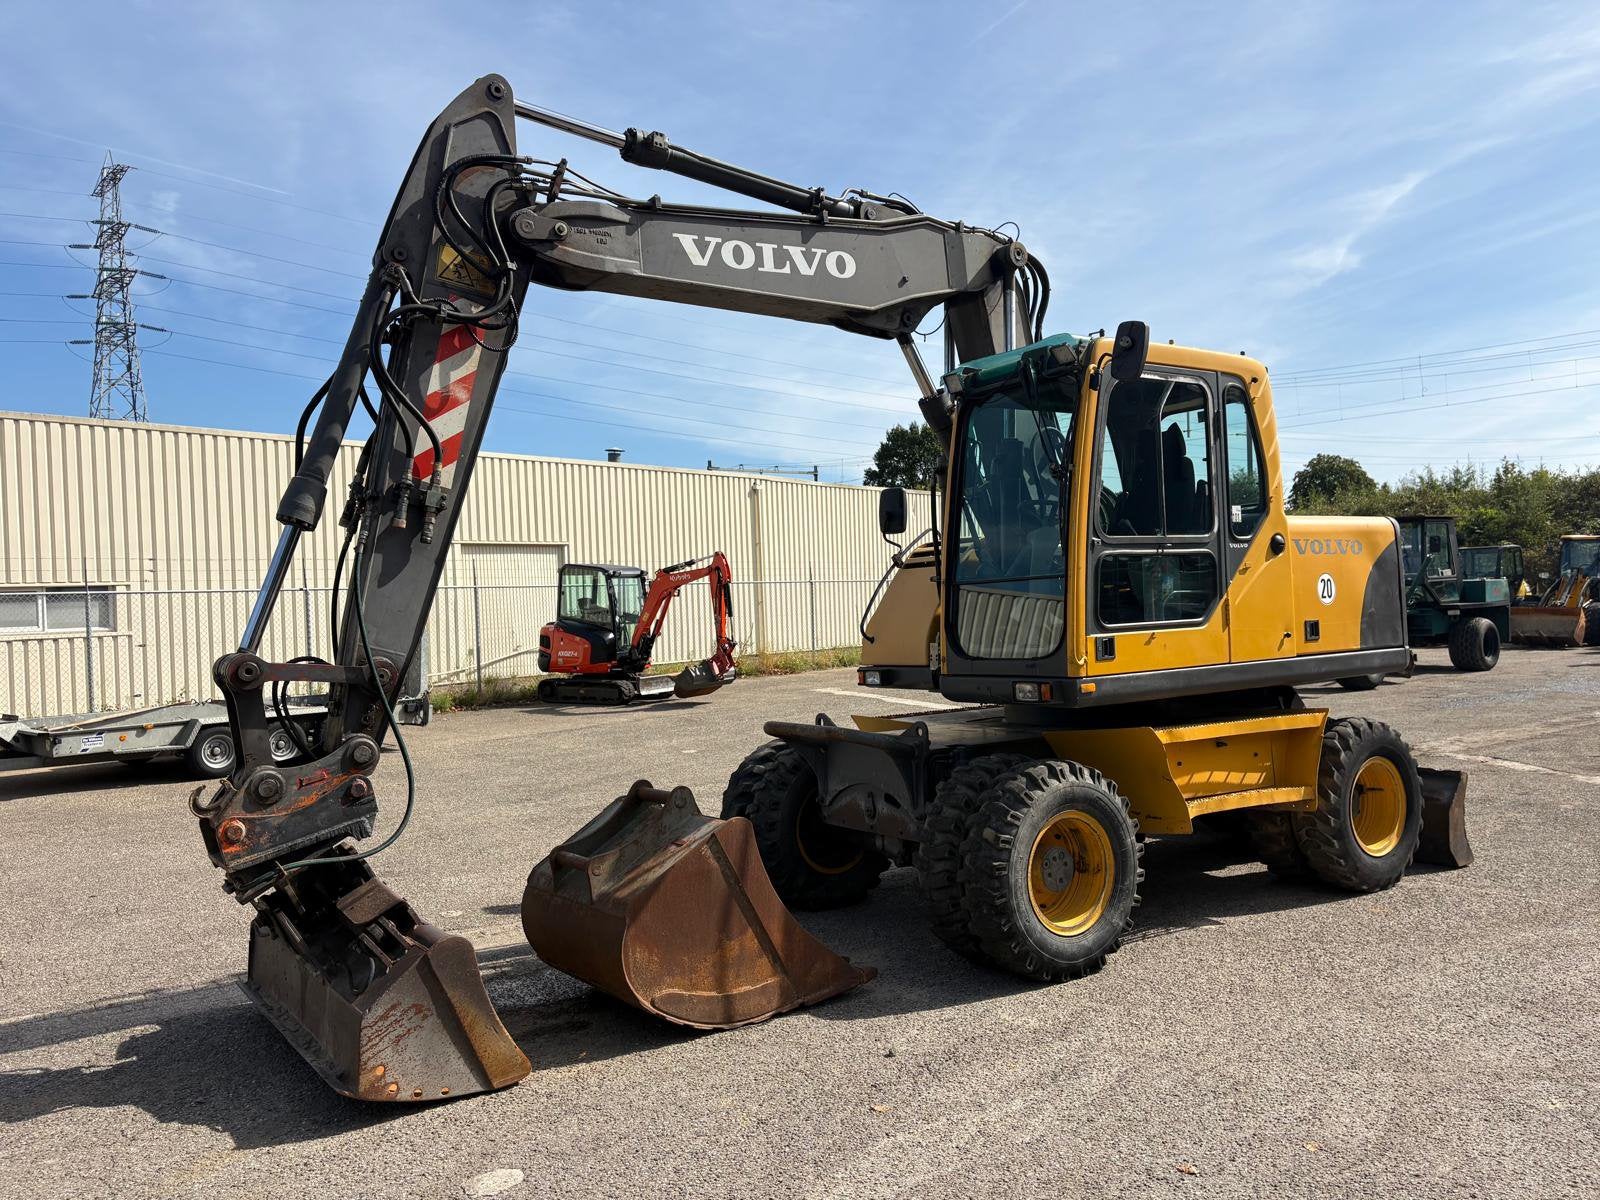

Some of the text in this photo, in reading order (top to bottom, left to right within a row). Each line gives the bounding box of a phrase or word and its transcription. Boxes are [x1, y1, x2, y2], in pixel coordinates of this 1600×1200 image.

[672, 232, 857, 279] VOLVO
[1292, 538, 1363, 555] VOLVO
[1320, 578, 1333, 599] 20
